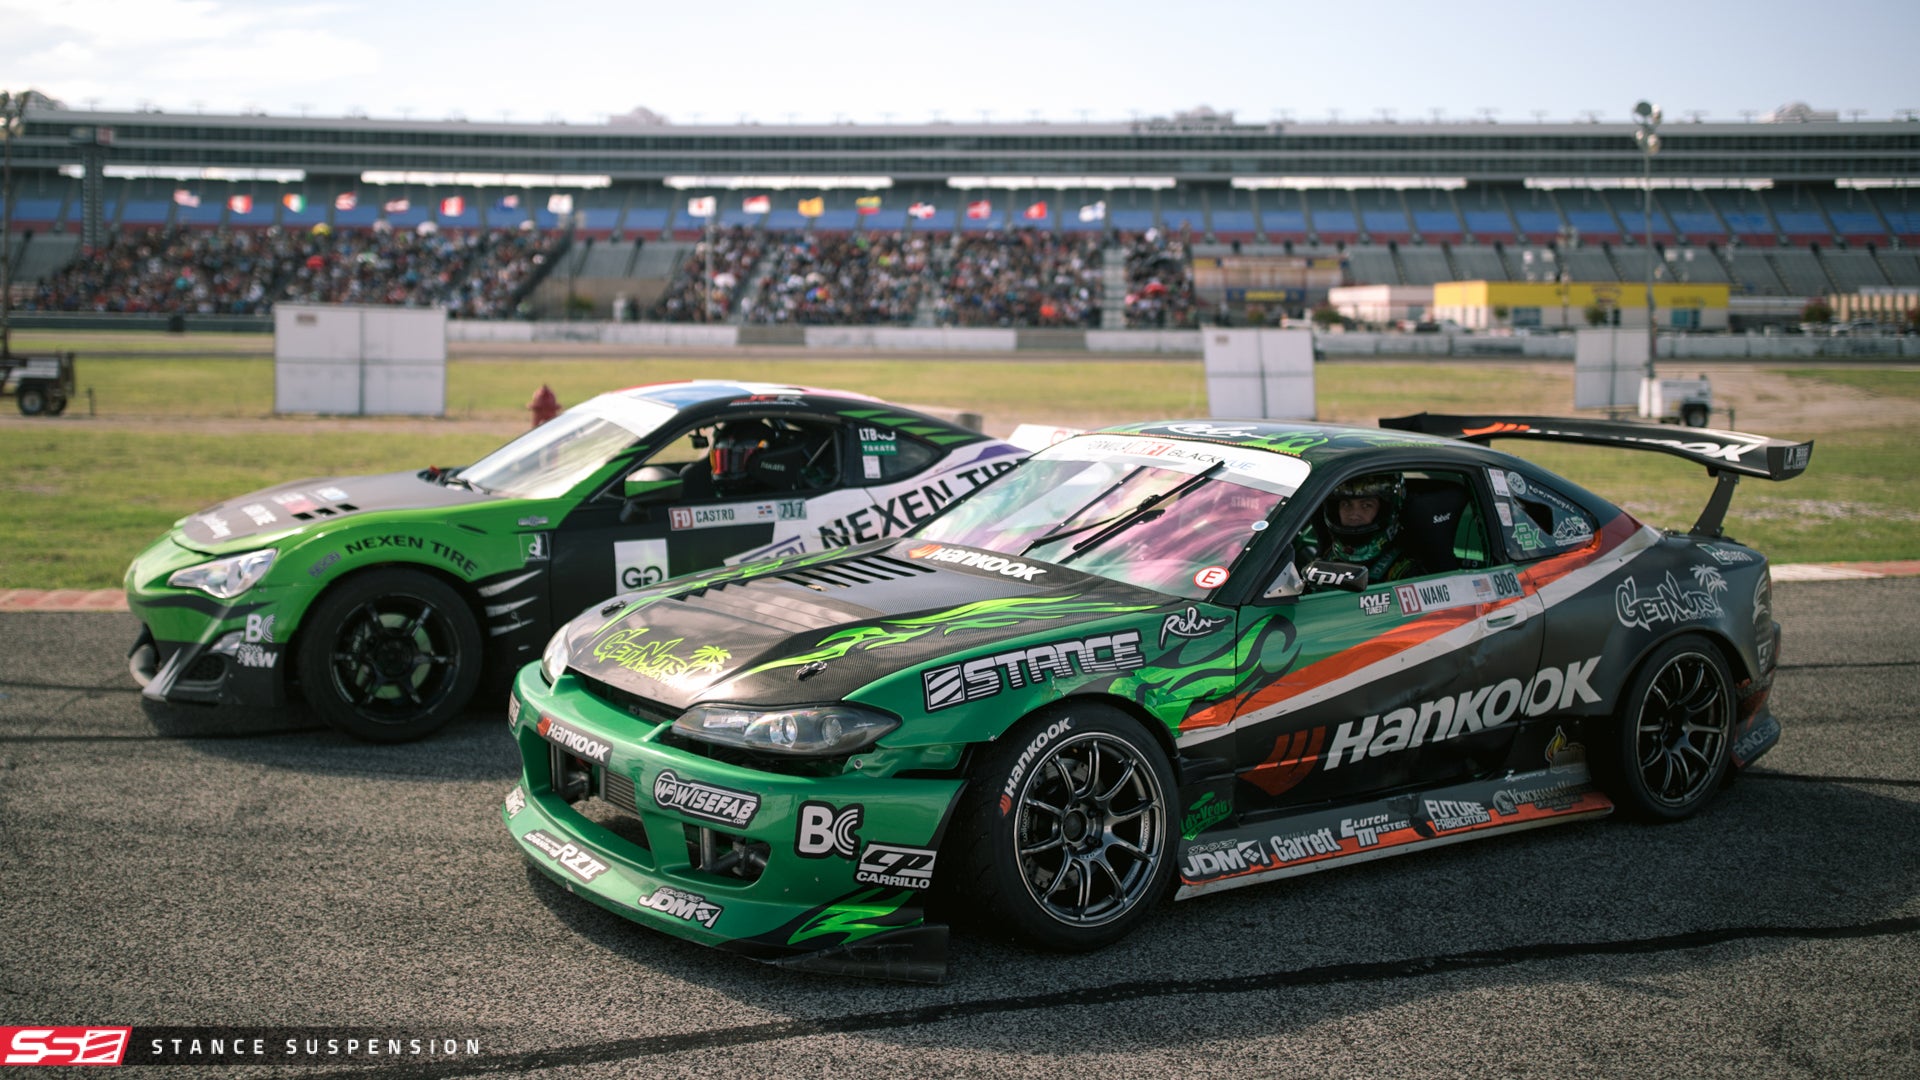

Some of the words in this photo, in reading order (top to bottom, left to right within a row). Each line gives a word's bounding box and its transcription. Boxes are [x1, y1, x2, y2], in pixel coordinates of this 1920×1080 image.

[673, 510, 692, 528] FD
[695, 508, 735, 523] CASTRO
[779, 502, 805, 519] 717
[818, 480, 954, 549] NEXEN
[344, 534, 424, 555] NEXEN
[430, 540, 478, 577] TIRE
[1202, 569, 1222, 585] E
[1359, 593, 1391, 609] KYLE
[1398, 587, 1419, 613] FD
[1419, 585, 1450, 605] WANG
[1493, 573, 1519, 597] 808
[1366, 606, 1382, 615] TUNED
[243, 651, 278, 668] KW
[963, 632, 1144, 700] STANCE
[674, 785, 758, 820] WISEFAB
[1424, 800, 1489, 819] FUTURE
[1340, 814, 1389, 838] CLUTCH
[1434, 813, 1491, 831] FABRICATION
[1270, 828, 1342, 862] Garrett
[1181, 848, 1248, 878] JDM
[856, 871, 931, 889] CARRILLO
[639, 891, 699, 920] JDM
